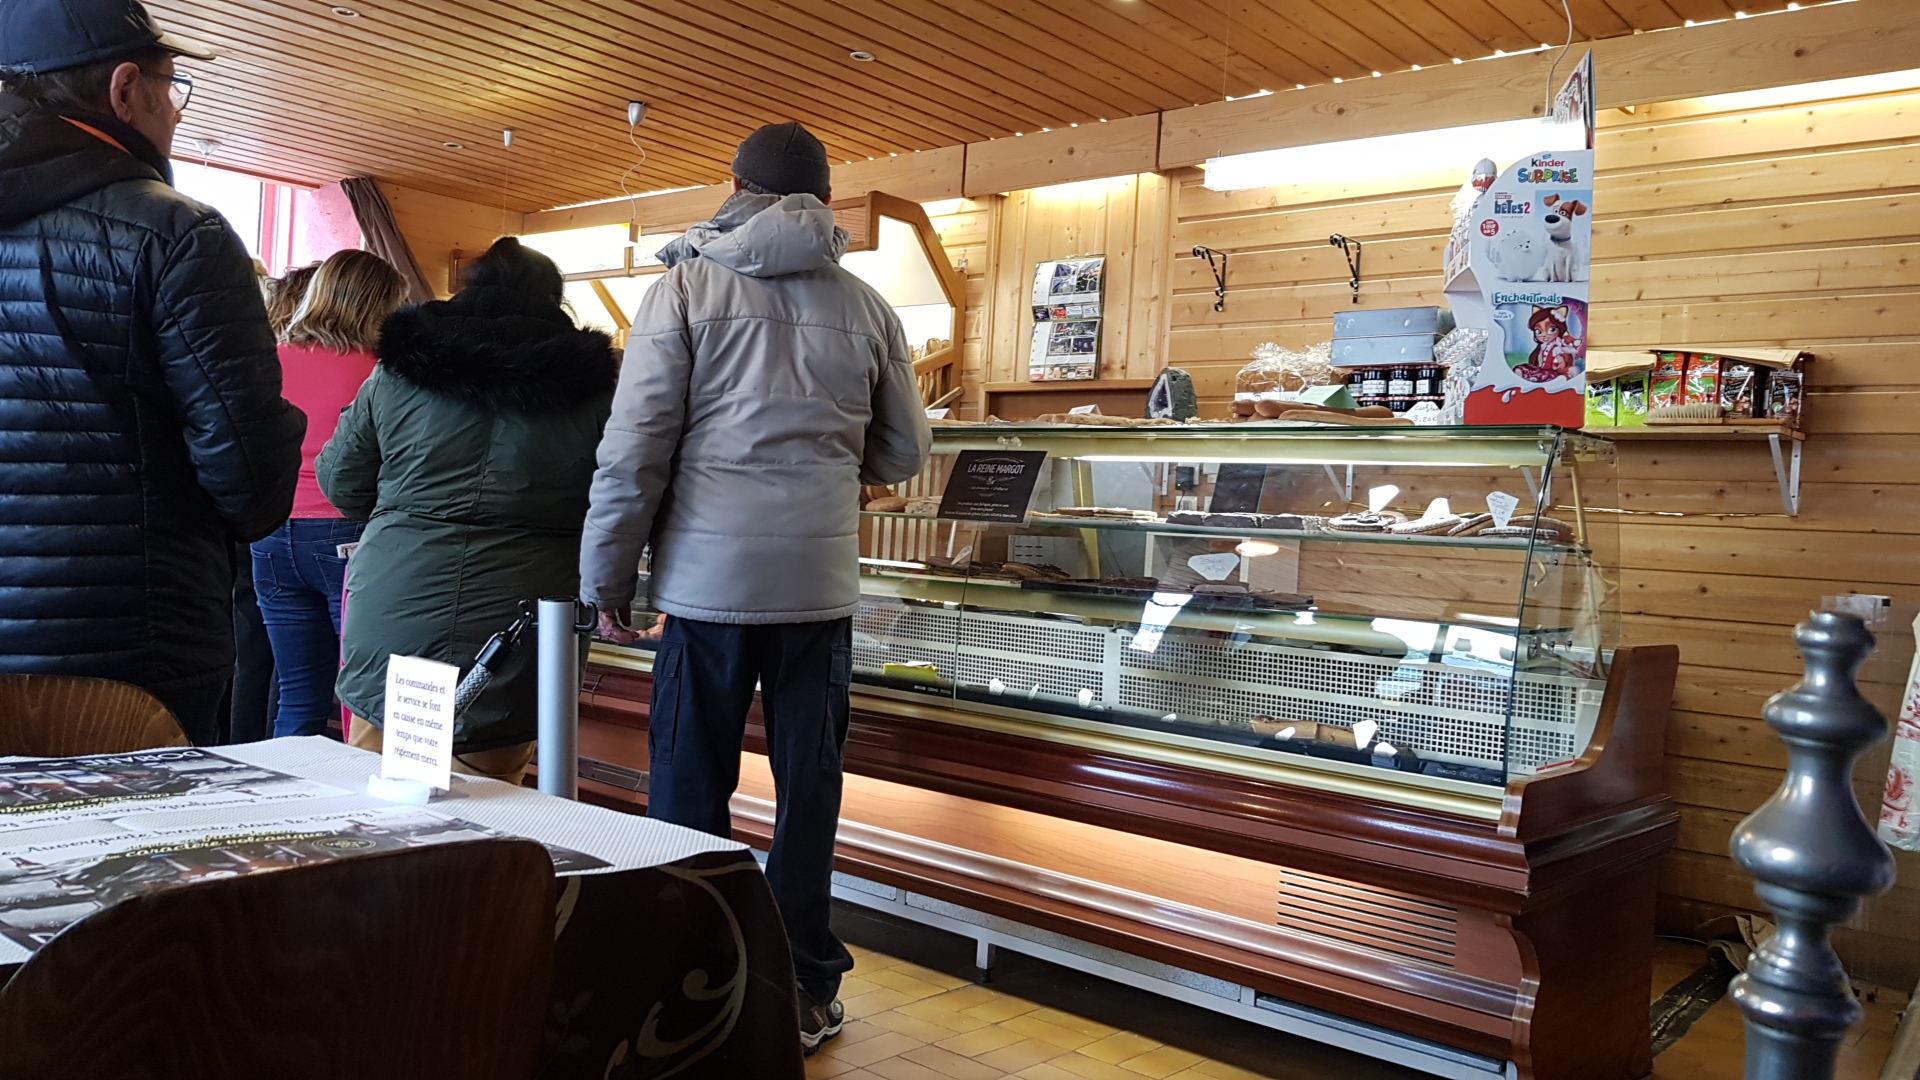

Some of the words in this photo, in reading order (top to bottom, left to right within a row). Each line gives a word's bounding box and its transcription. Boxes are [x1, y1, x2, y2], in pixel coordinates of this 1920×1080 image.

[1531, 158, 1565, 167] Kinder
[1518, 168, 1578, 184] SURPRISE
[1524, 202, 1531, 214] 2
[968, 463, 976, 473] LA
[977, 463, 997, 474] REINE
[996, 464, 1025, 475] MARGOT
[395, 673, 405, 685] Les
[406, 679, 438, 693] commandes
[439, 686, 446, 694] et
[397, 691, 402, 702] le
[403, 695, 421, 707] service
[422, 701, 428, 709] se
[429, 699, 441, 712] font
[401, 712, 416, 723] caisse
[417, 718, 424, 726] en
[425, 719, 443, 731] même
[396, 729, 412, 742] temps
[413, 735, 423, 744] que
[424, 737, 438, 748] votre
